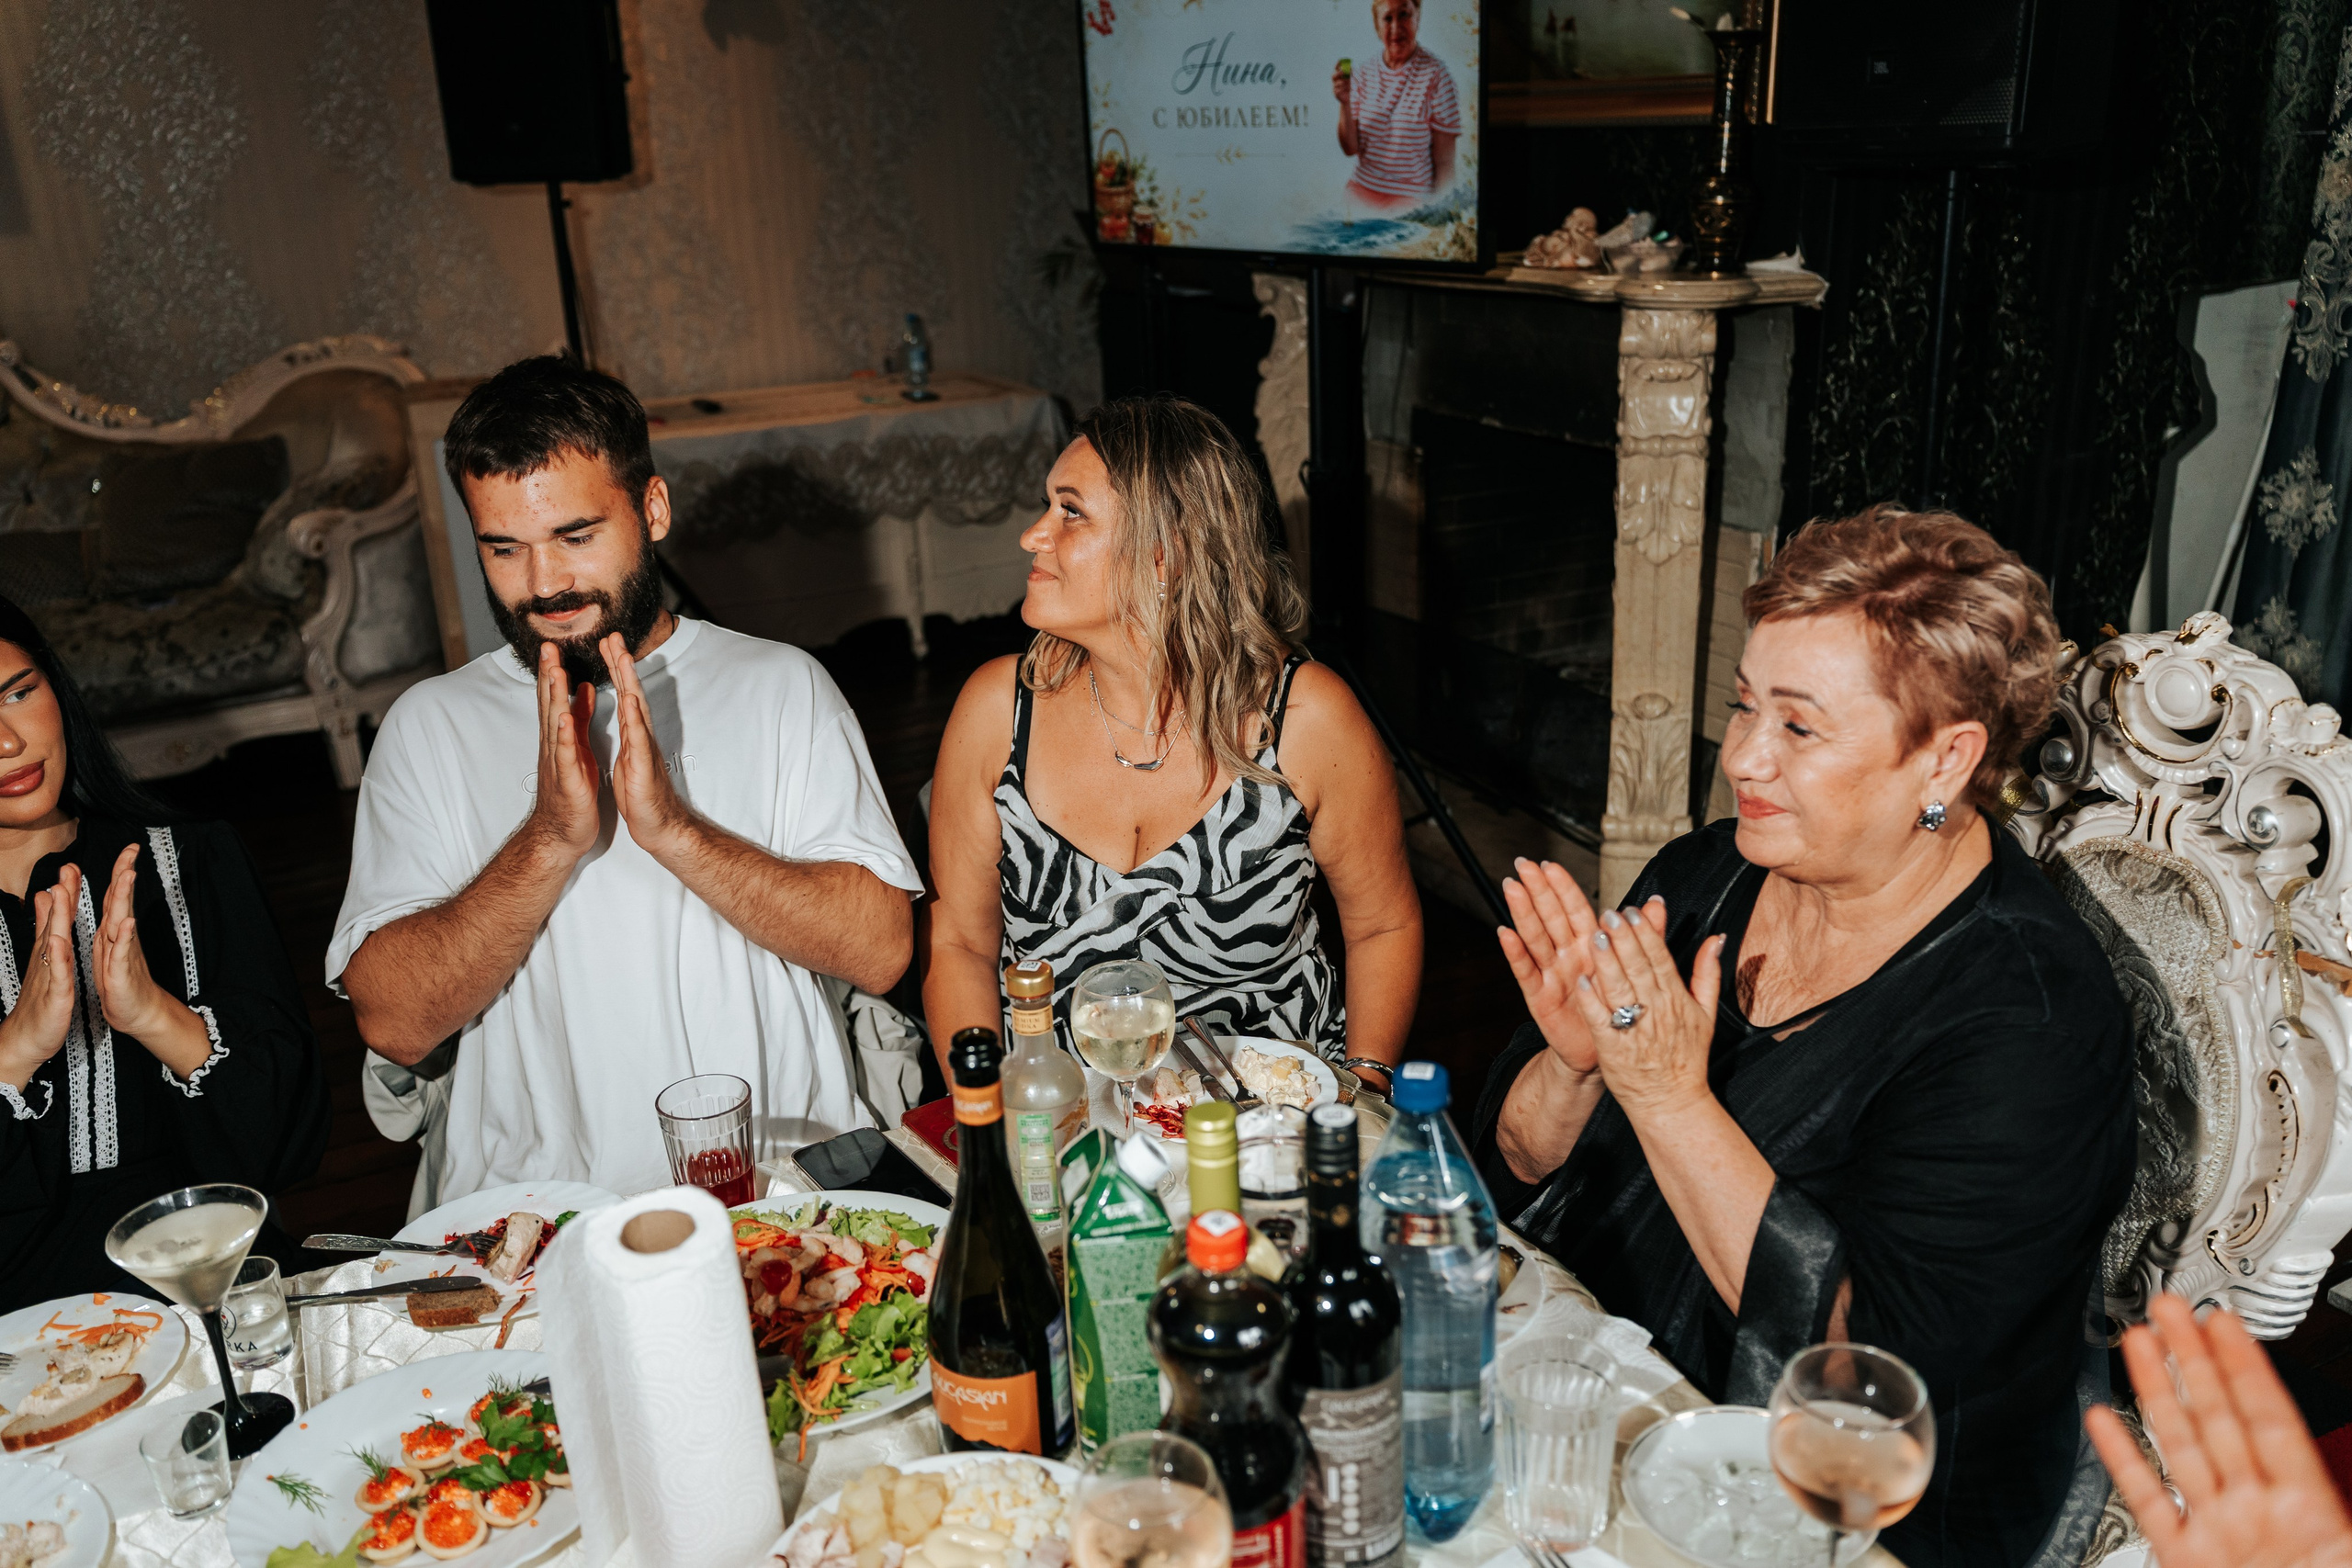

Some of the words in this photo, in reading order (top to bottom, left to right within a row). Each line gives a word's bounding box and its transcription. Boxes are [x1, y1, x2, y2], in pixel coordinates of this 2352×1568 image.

[1170, 30, 1287, 96] Нина,
[1152, 106, 1168, 129] С
[1176, 104, 1309, 130] ЮБИЛЕЕМ!
[225, 1339, 258, 1353] RKA
[932, 1371, 1008, 1412] AUCASIAN
